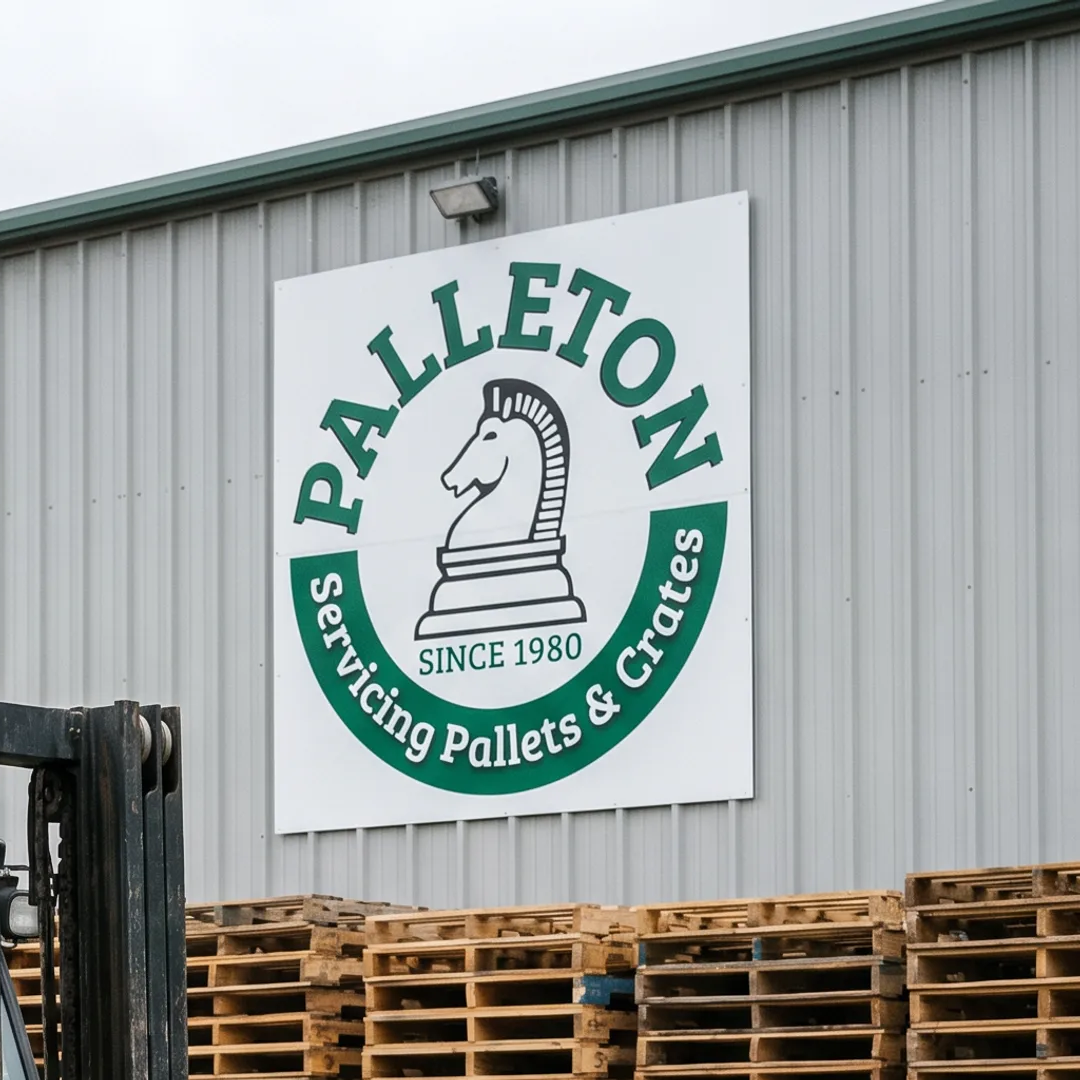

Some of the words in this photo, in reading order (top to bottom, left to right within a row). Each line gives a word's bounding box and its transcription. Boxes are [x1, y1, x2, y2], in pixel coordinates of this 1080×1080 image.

[293, 261, 724, 535] PALLETON
[310, 572, 436, 764] Servicing
[439, 713, 582, 769] Pallets
[585, 683, 621, 726] &
[615, 527, 705, 690] Crates
[418, 640, 505, 676] SINCE
[514, 632, 583, 667] 1980
